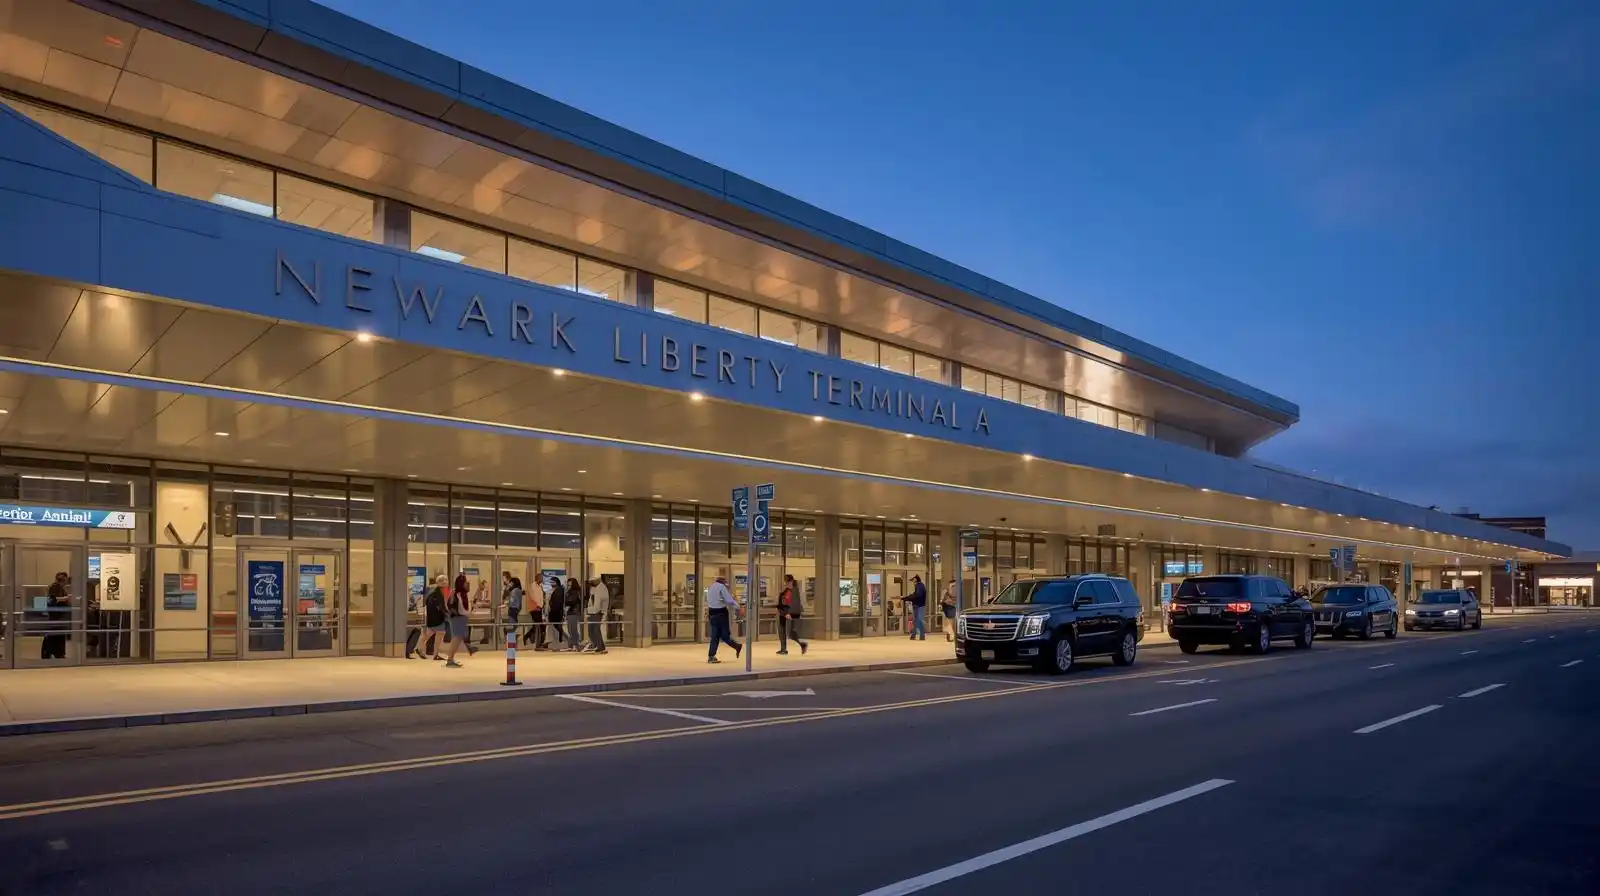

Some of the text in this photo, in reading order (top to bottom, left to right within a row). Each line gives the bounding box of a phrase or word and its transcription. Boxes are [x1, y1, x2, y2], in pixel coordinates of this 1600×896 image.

[274, 247, 992, 436] NEWARK LIBERTY TERMINAL A
